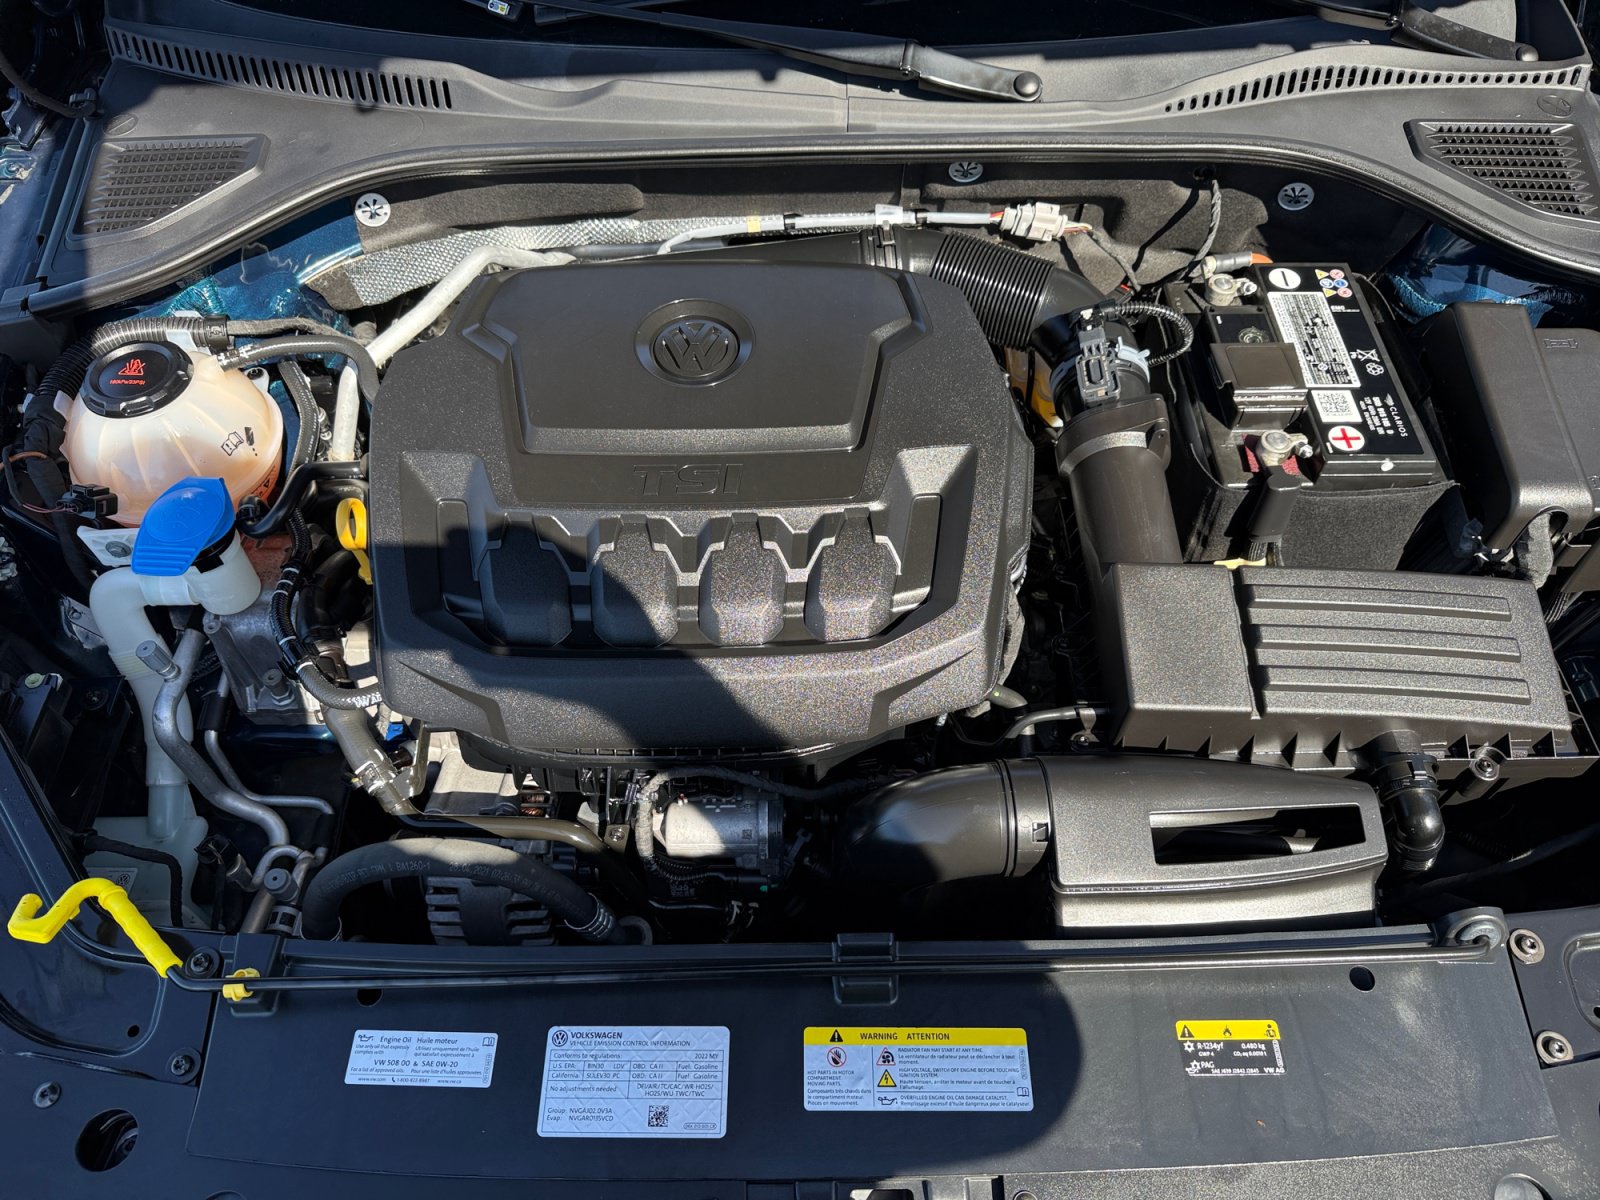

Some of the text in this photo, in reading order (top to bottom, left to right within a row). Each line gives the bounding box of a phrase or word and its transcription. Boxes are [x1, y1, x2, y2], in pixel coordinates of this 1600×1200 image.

[1389, 406, 1408, 437] CLARIOS
[633, 464, 743, 496] TSI
[571, 1031, 623, 1039] VOLKSWAGEN
[860, 1032, 950, 1040] WARNING ATTENTION
[380, 1036, 402, 1044] Engine
[1197, 1042, 1223, 1051] R-1234yf
[1258, 1042, 1266, 1050] kg
